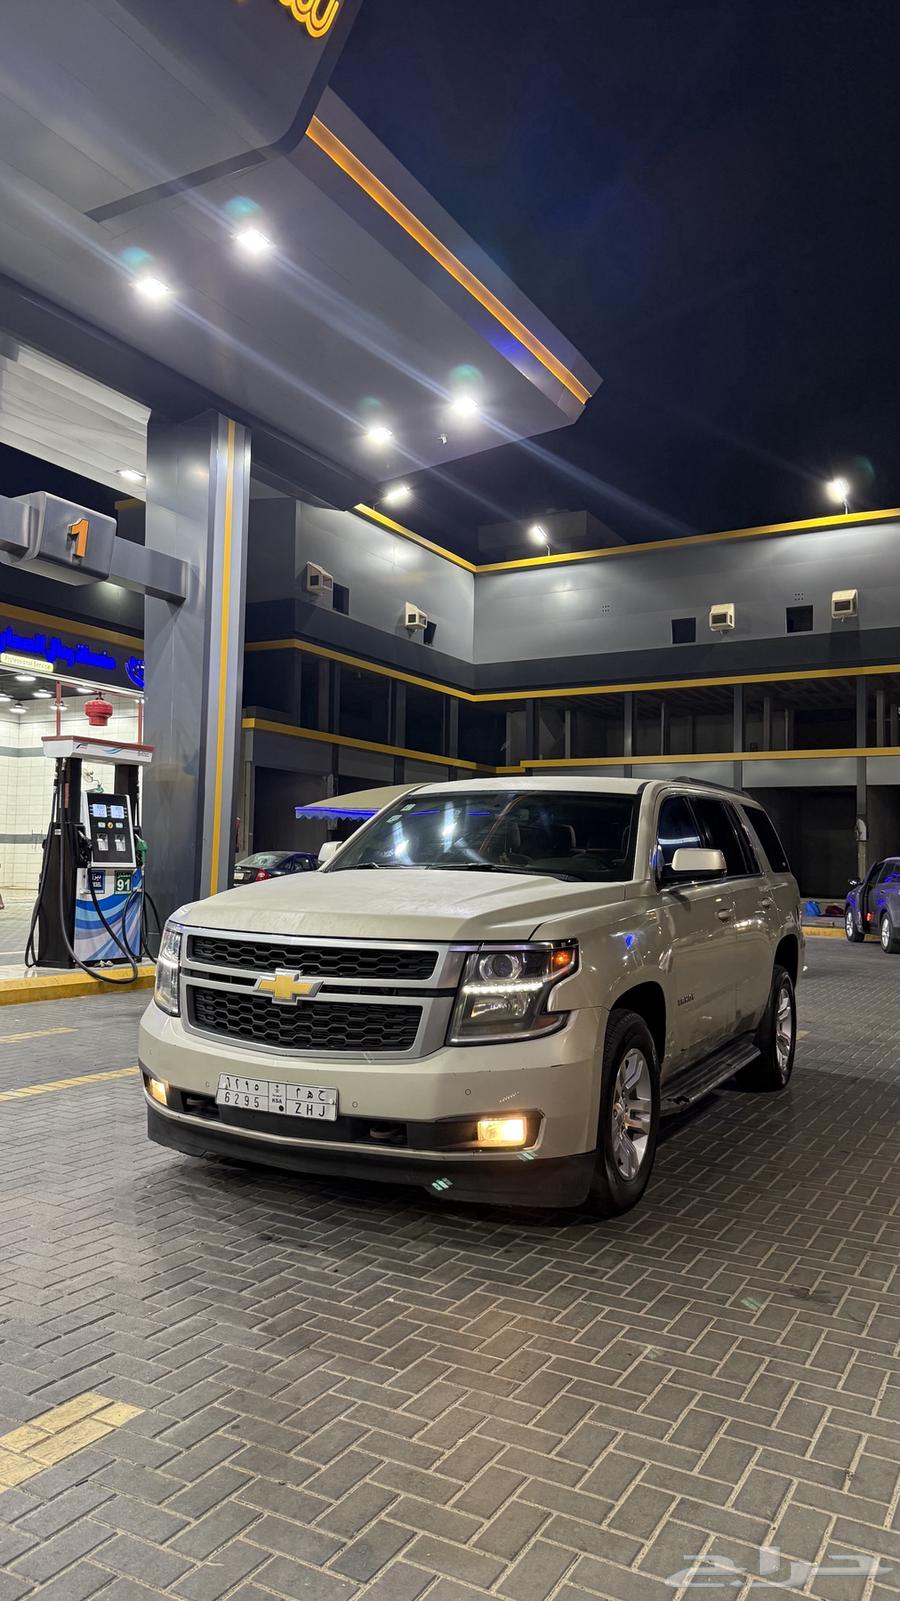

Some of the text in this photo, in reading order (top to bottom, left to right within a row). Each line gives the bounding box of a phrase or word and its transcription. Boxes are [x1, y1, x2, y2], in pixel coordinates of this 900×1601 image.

[67, 517, 90, 561] 1
[117, 879, 131, 891] 91
[224, 1091, 260, 1108] 6295
[295, 1102, 326, 1117] ZHJ
